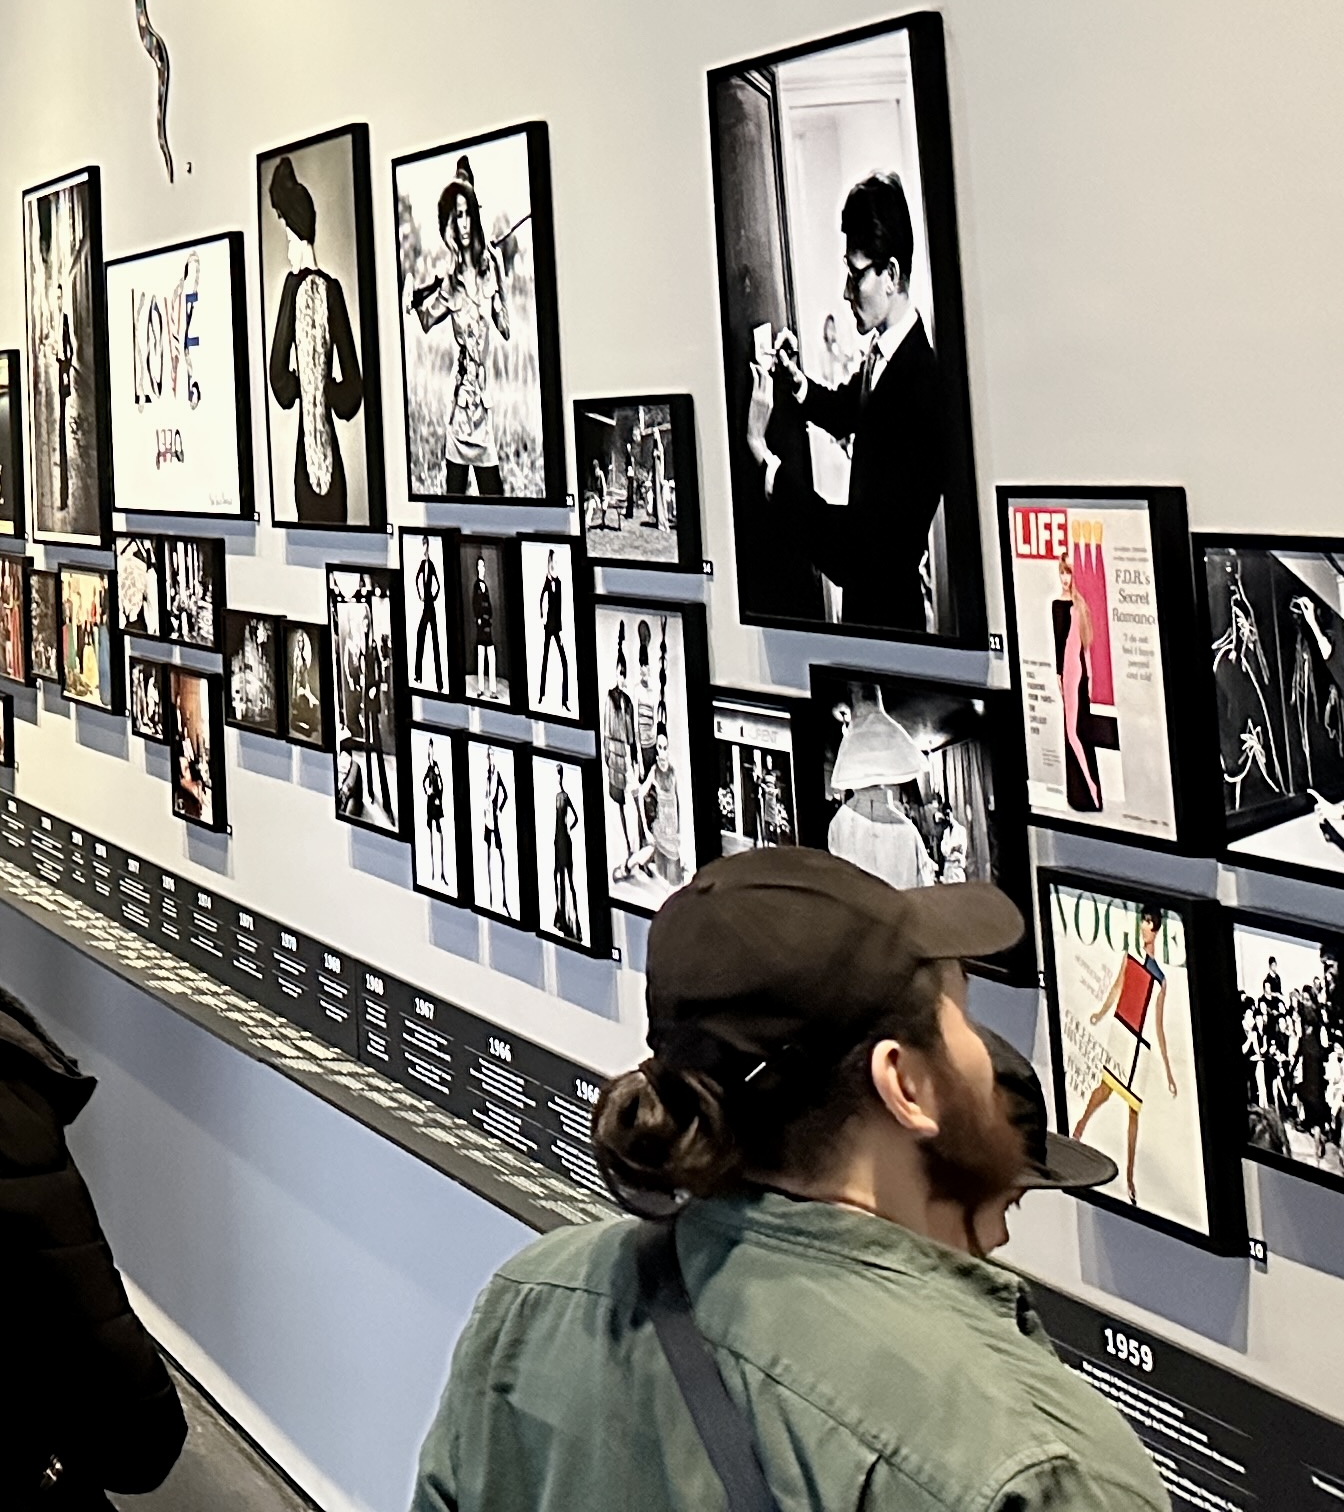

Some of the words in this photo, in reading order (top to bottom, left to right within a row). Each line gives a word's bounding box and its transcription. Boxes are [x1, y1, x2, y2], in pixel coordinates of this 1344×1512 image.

[132, 251, 201, 413] LOVE
[1014, 511, 1067, 557] LIFE
[990, 636, 1001, 649] 11
[415, 997, 434, 1020] 1967
[489, 1036, 511, 1062] 1966
[1249, 1241, 1263, 1258] 10
[1104, 1328, 1154, 1372] 1959
